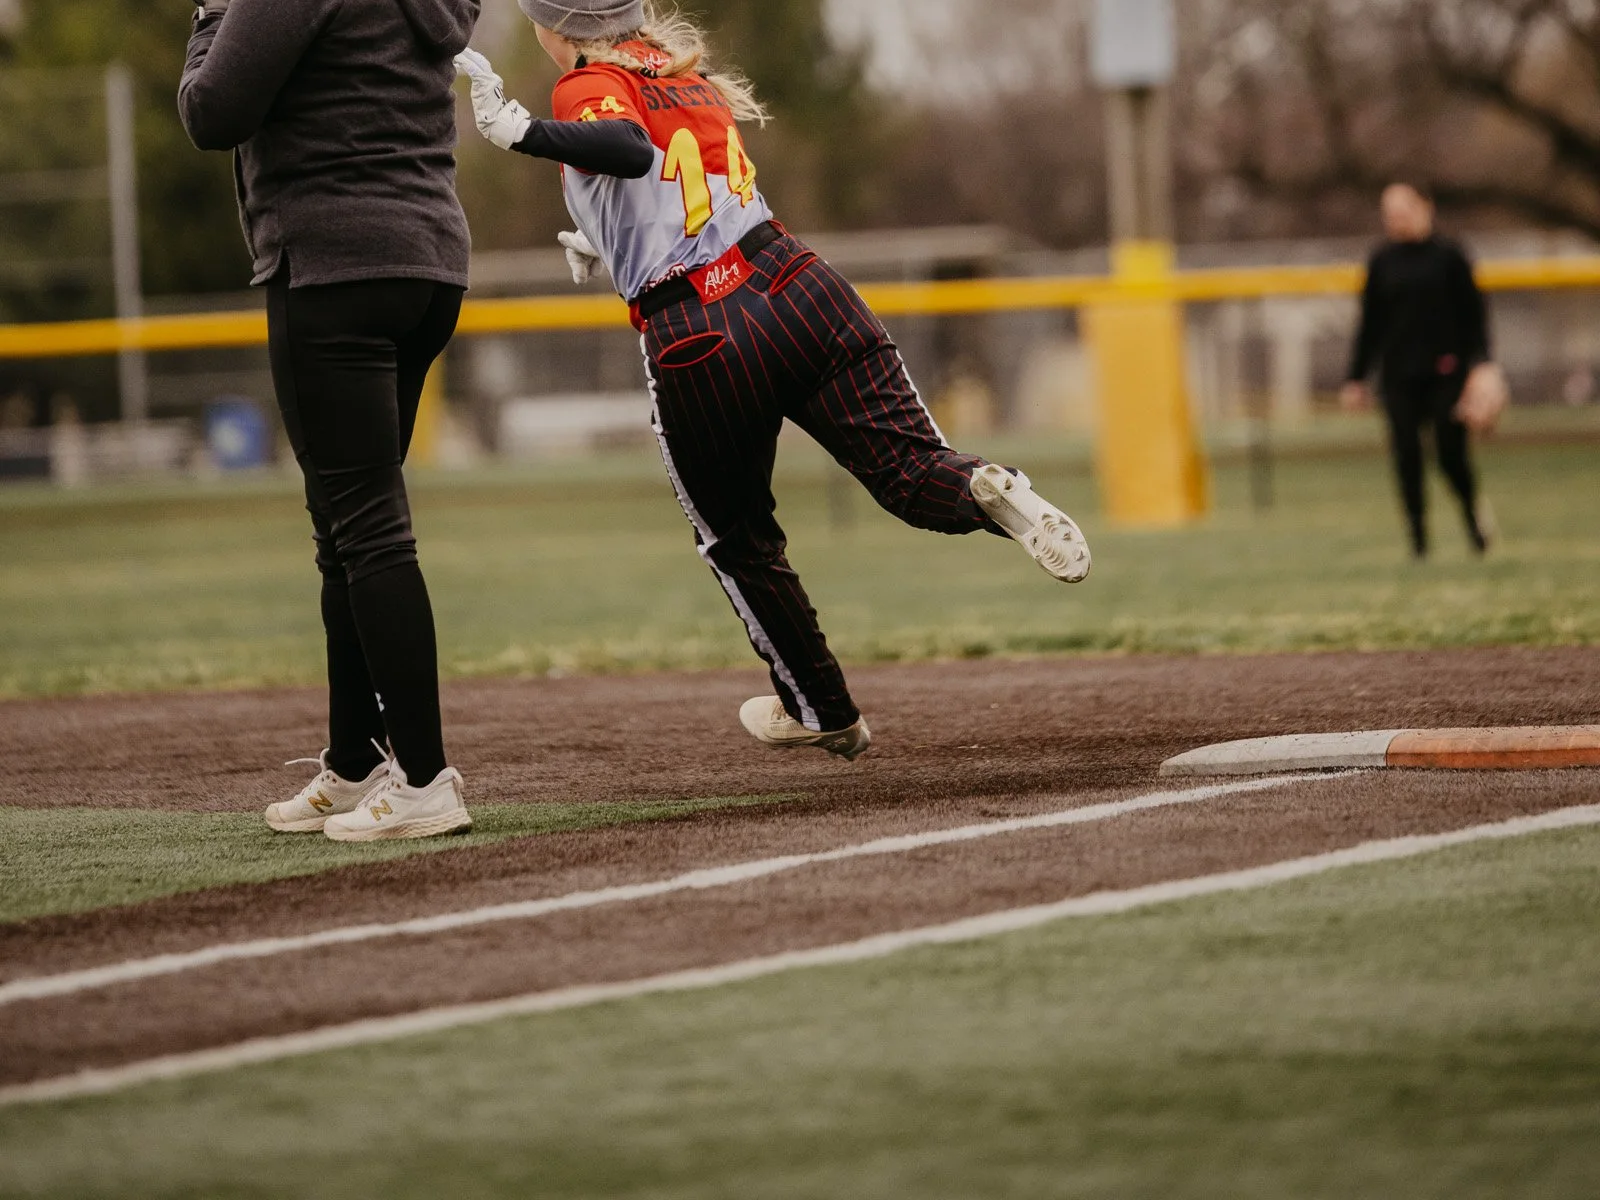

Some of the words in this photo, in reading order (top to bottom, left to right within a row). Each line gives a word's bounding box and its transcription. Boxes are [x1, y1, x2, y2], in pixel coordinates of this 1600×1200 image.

[579, 95, 625, 122] 14
[660, 125, 756, 238] 14
[307, 790, 333, 813] N
[370, 798, 393, 822] N
